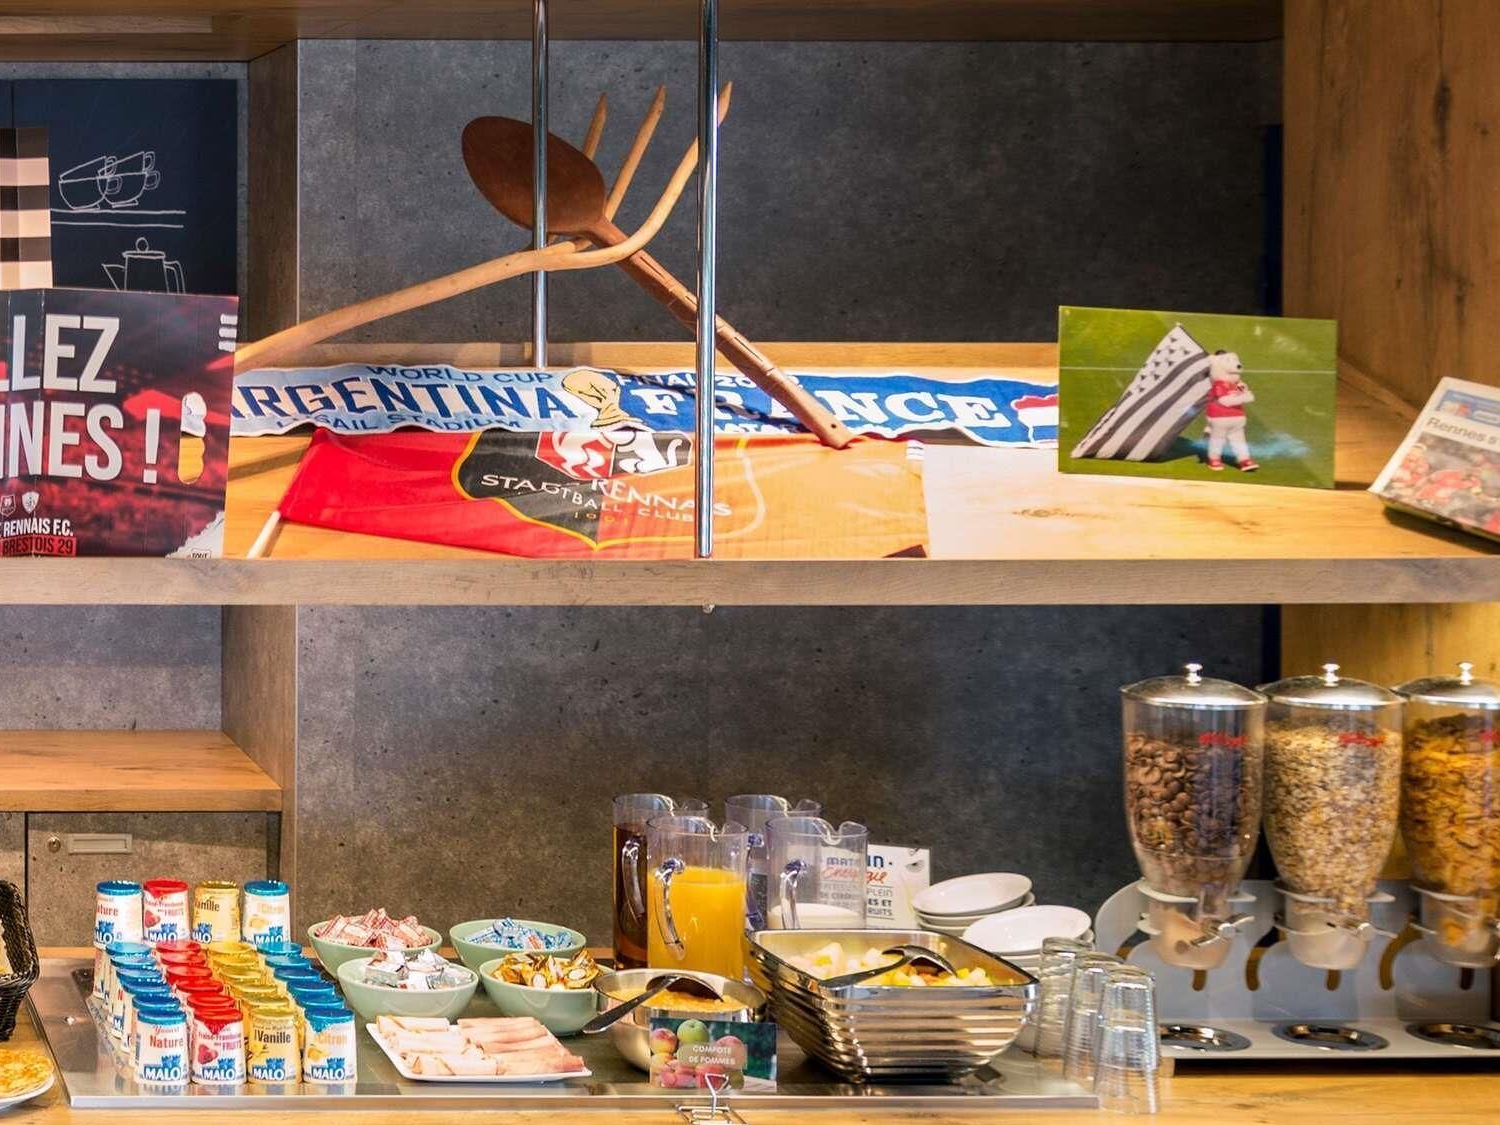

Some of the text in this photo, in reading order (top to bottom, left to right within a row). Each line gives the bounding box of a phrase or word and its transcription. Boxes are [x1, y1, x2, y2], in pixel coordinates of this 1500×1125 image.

[367, 366, 553, 383] WORLD CUP
[1427, 417, 1487, 442] Rennes
[143, 408, 161, 484] !
[589, 478, 733, 517] RENNAS
[3, 517, 51, 538] RENNAIS
[52, 519, 74, 537] F.C.
[2, 536, 53, 556] BRESTOIS
[57, 539, 73, 555] 29
[148, 930, 178, 942] MALO
[149, 1035, 184, 1049] Nature
[257, 1030, 291, 1043] Vanille
[692, 1045, 732, 1054] COMPOTE
[688, 1055, 736, 1066] DE POMMES
[144, 1065, 181, 1081] MALO
[202, 1067, 236, 1081] MALO
[253, 1067, 285, 1080] MALO
[312, 1067, 345, 1080] MALO
